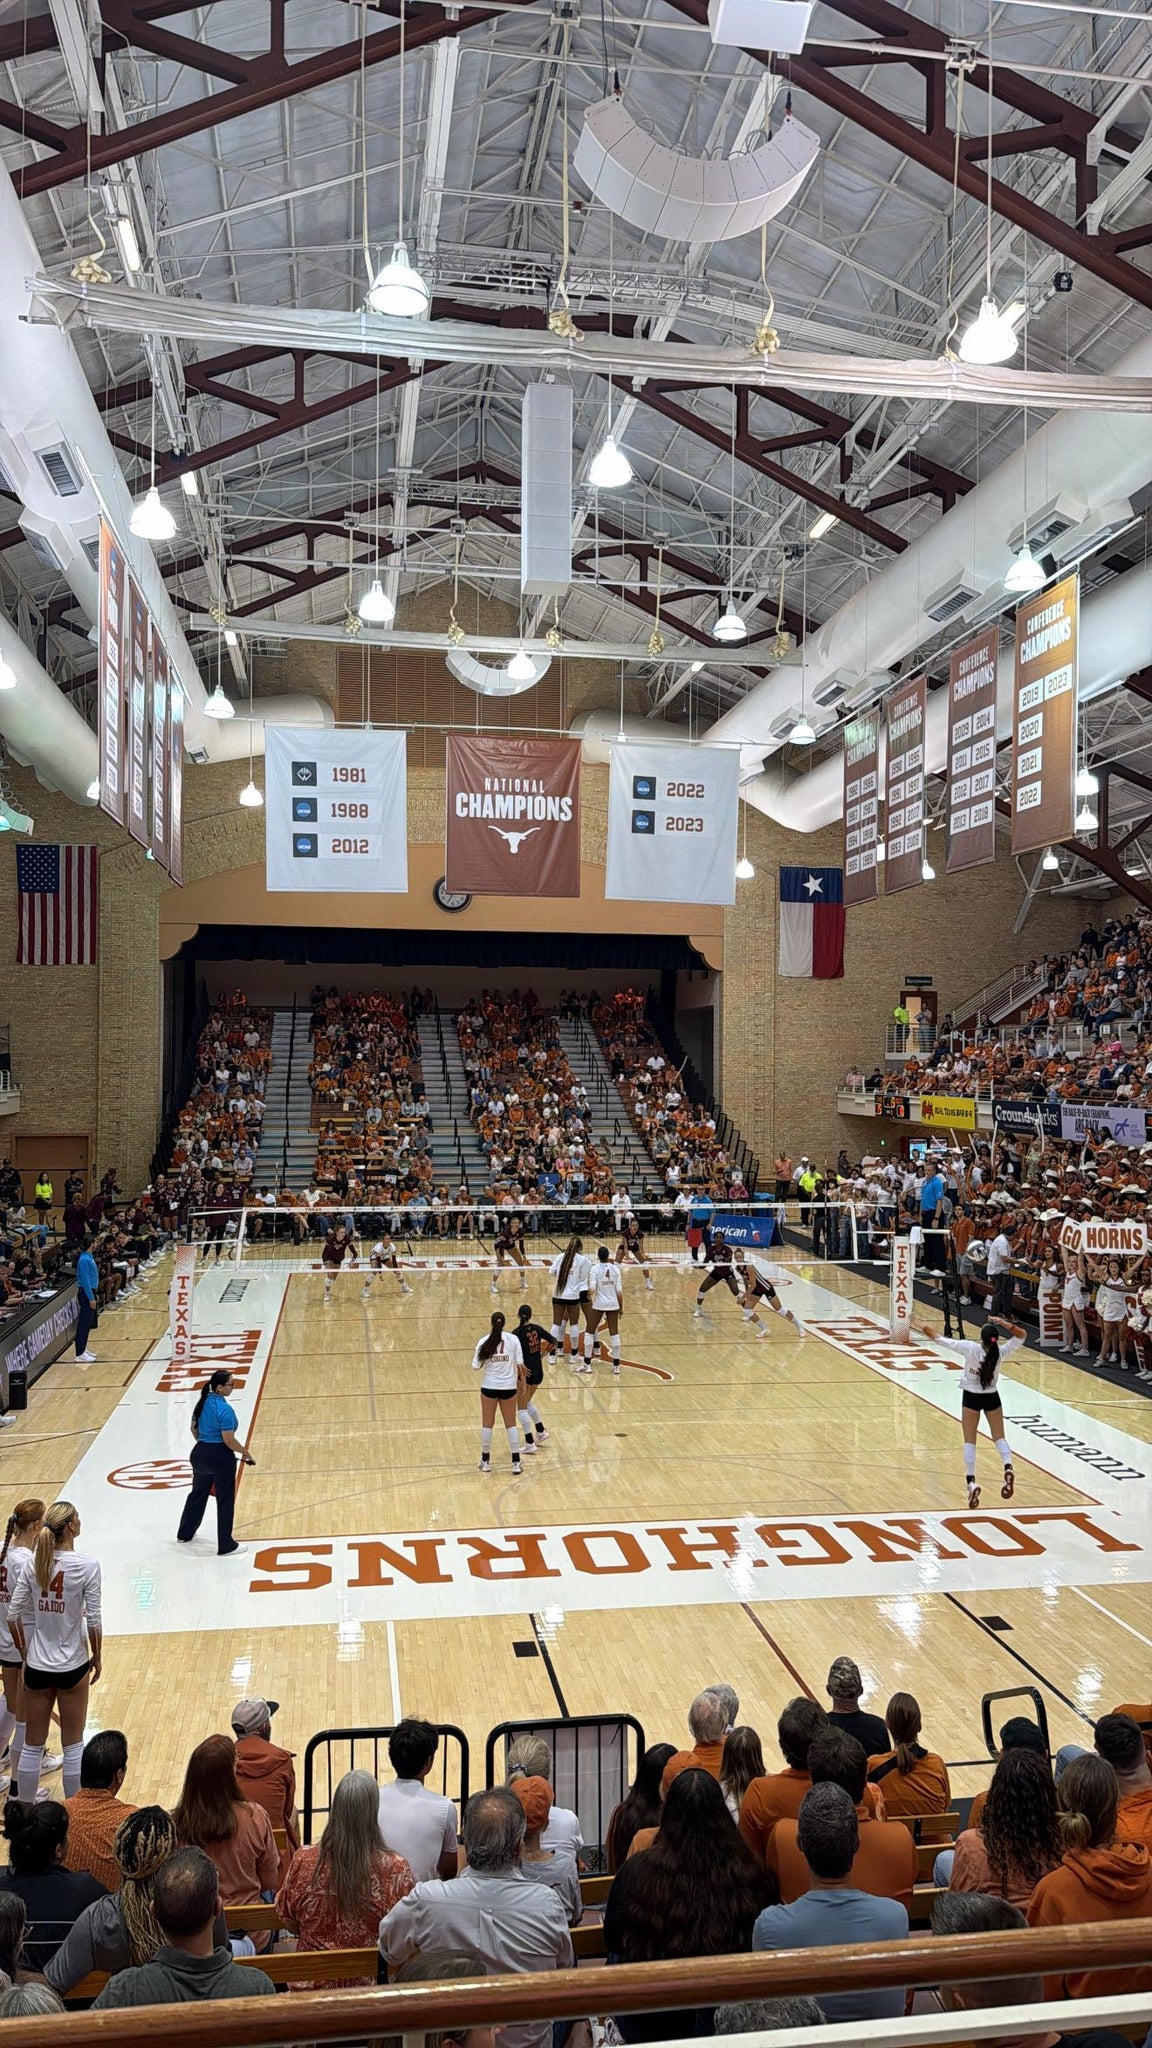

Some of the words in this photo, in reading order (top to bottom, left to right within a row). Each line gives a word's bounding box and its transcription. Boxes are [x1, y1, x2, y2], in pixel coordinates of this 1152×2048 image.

[1020, 616, 1072, 664] CHAMPIONS
[953, 661, 994, 702] CHAMPIONS
[1022, 686, 1039, 707] 2019
[1048, 671, 1068, 693] 2023
[332, 767, 366, 783] 1981
[484, 777, 545, 794] NATIONAL
[666, 782, 705, 799] 2022
[331, 803, 368, 818] 1988
[455, 792, 573, 822] CHAMPIONS
[665, 816, 704, 832] 2023
[332, 838, 368, 854] 2012
[1062, 1225, 1082, 1250] GO
[1086, 1227, 1143, 1250] HORNS
[895, 1246, 909, 1319] TEXAS
[173, 1276, 191, 1355] TEXAS
[1043, 1292, 1064, 1341] POINT
[803, 1316, 964, 1371] TEXAS
[1003, 1415, 1146, 1481] humann
[249, 1512, 1144, 1593] LONGHORNS
[38, 1600, 65, 1614] GAIDO
